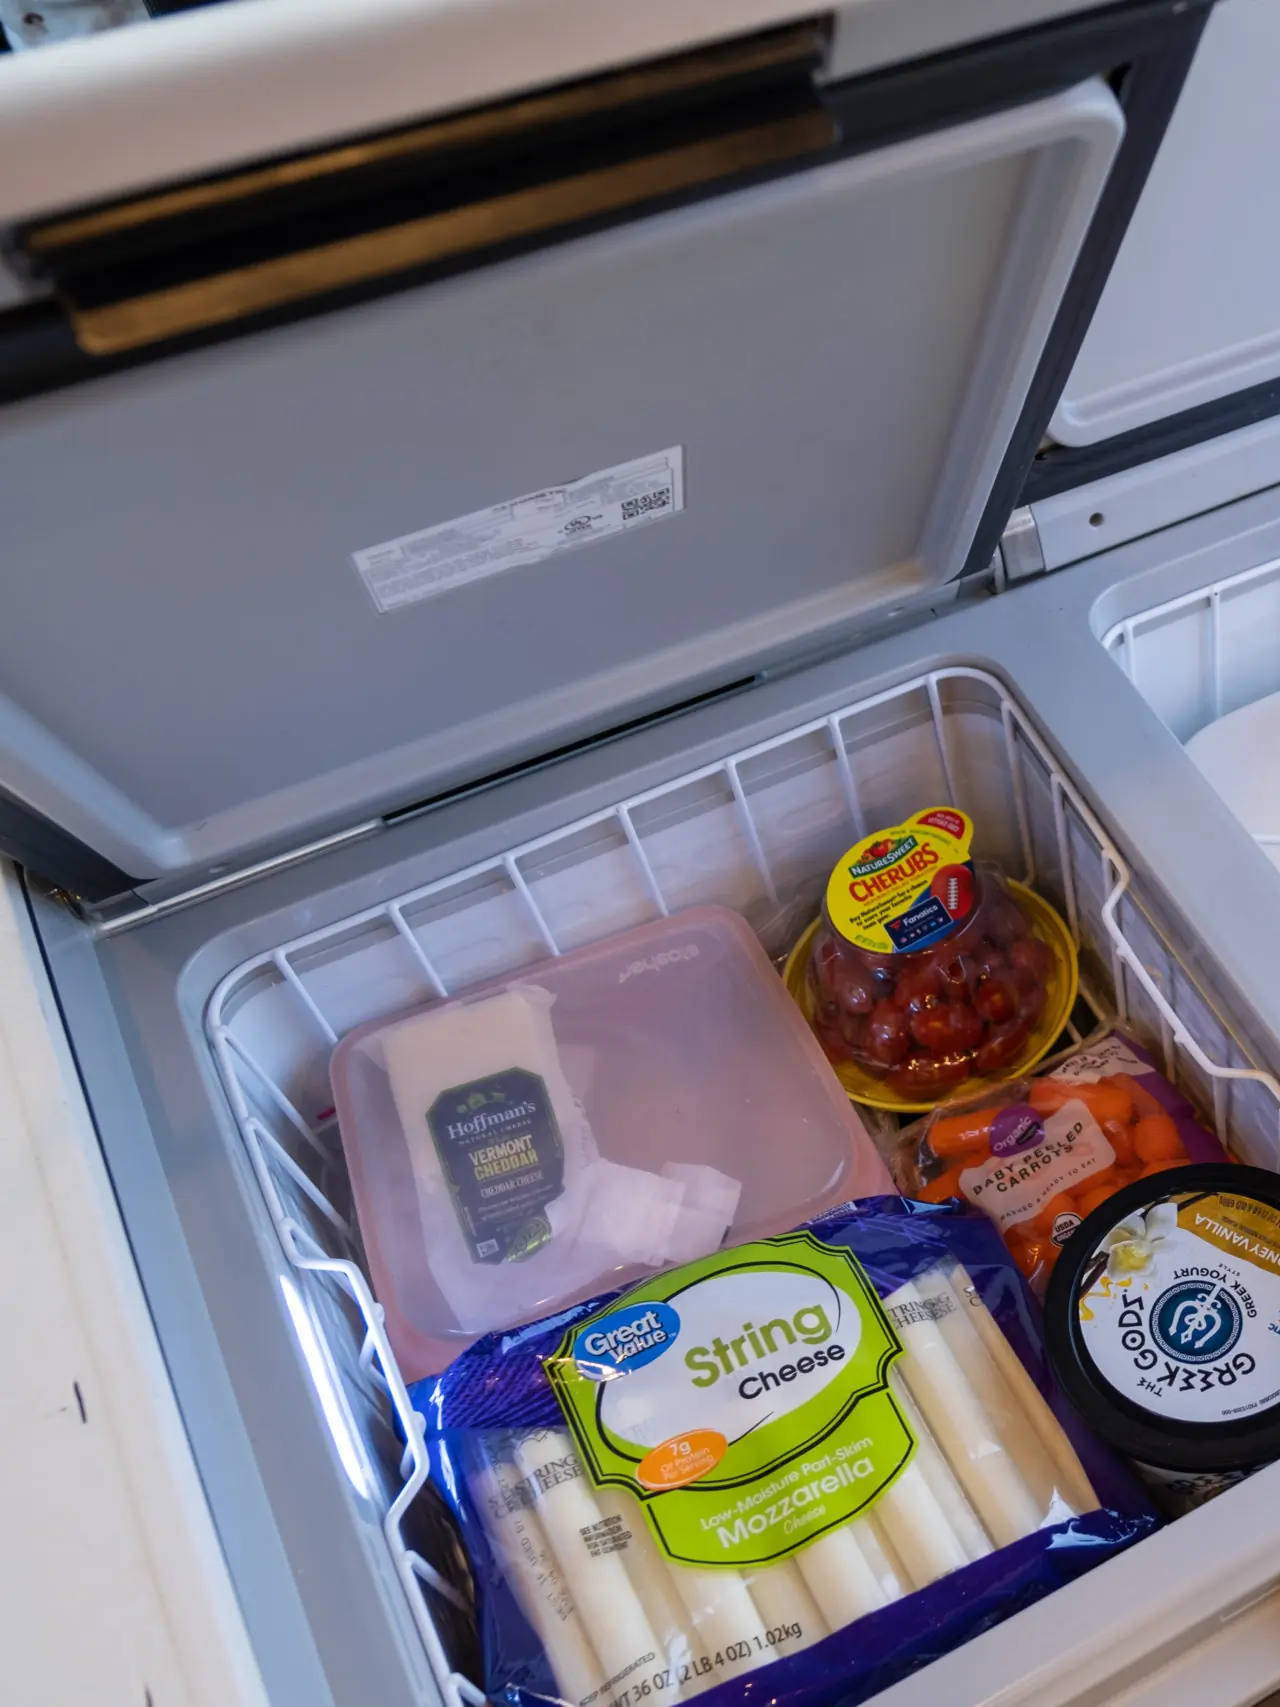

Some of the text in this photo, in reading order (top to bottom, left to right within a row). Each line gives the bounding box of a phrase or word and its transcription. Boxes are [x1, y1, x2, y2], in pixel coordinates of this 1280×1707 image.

[849, 842, 939, 902] CHERUBS
[903, 904, 938, 926] Fanatics
[446, 1101, 537, 1140] Hoffman's
[468, 1134, 533, 1166] VERMONT
[1023, 1122, 1083, 1164] PEELED
[473, 1150, 539, 1181] CHEDDAR
[480, 1170, 545, 1198] CHEDDAR CHEESE
[996, 1144, 1073, 1192] CARROTS
[1055, 1219, 1075, 1233] USDA
[1195, 1213, 1250, 1249] VANILLA
[887, 1296, 942, 1320] TRING
[1173, 1267, 1257, 1318] GREEK YOGURT
[585, 1310, 661, 1357] Great
[684, 1303, 833, 1388] String
[739, 1344, 845, 1400] Cheese
[1156, 1352, 1257, 1393] GREEK
[669, 1441, 691, 1456] 7g
[700, 1436, 873, 1531] Low-Moisture Part-Skim
[715, 1457, 875, 1549] Mozzarella
[783, 1505, 826, 1535] Cheese
[601, 1652, 655, 1693] REFRIGERATED
[633, 1680, 651, 1701] 36
[653, 1669, 674, 1691] OZ
[692, 1657, 713, 1677] LB
[714, 1652, 725, 1667] 4
[725, 1643, 752, 1662] OZ)
[753, 1621, 803, 1653] 1.02kg
